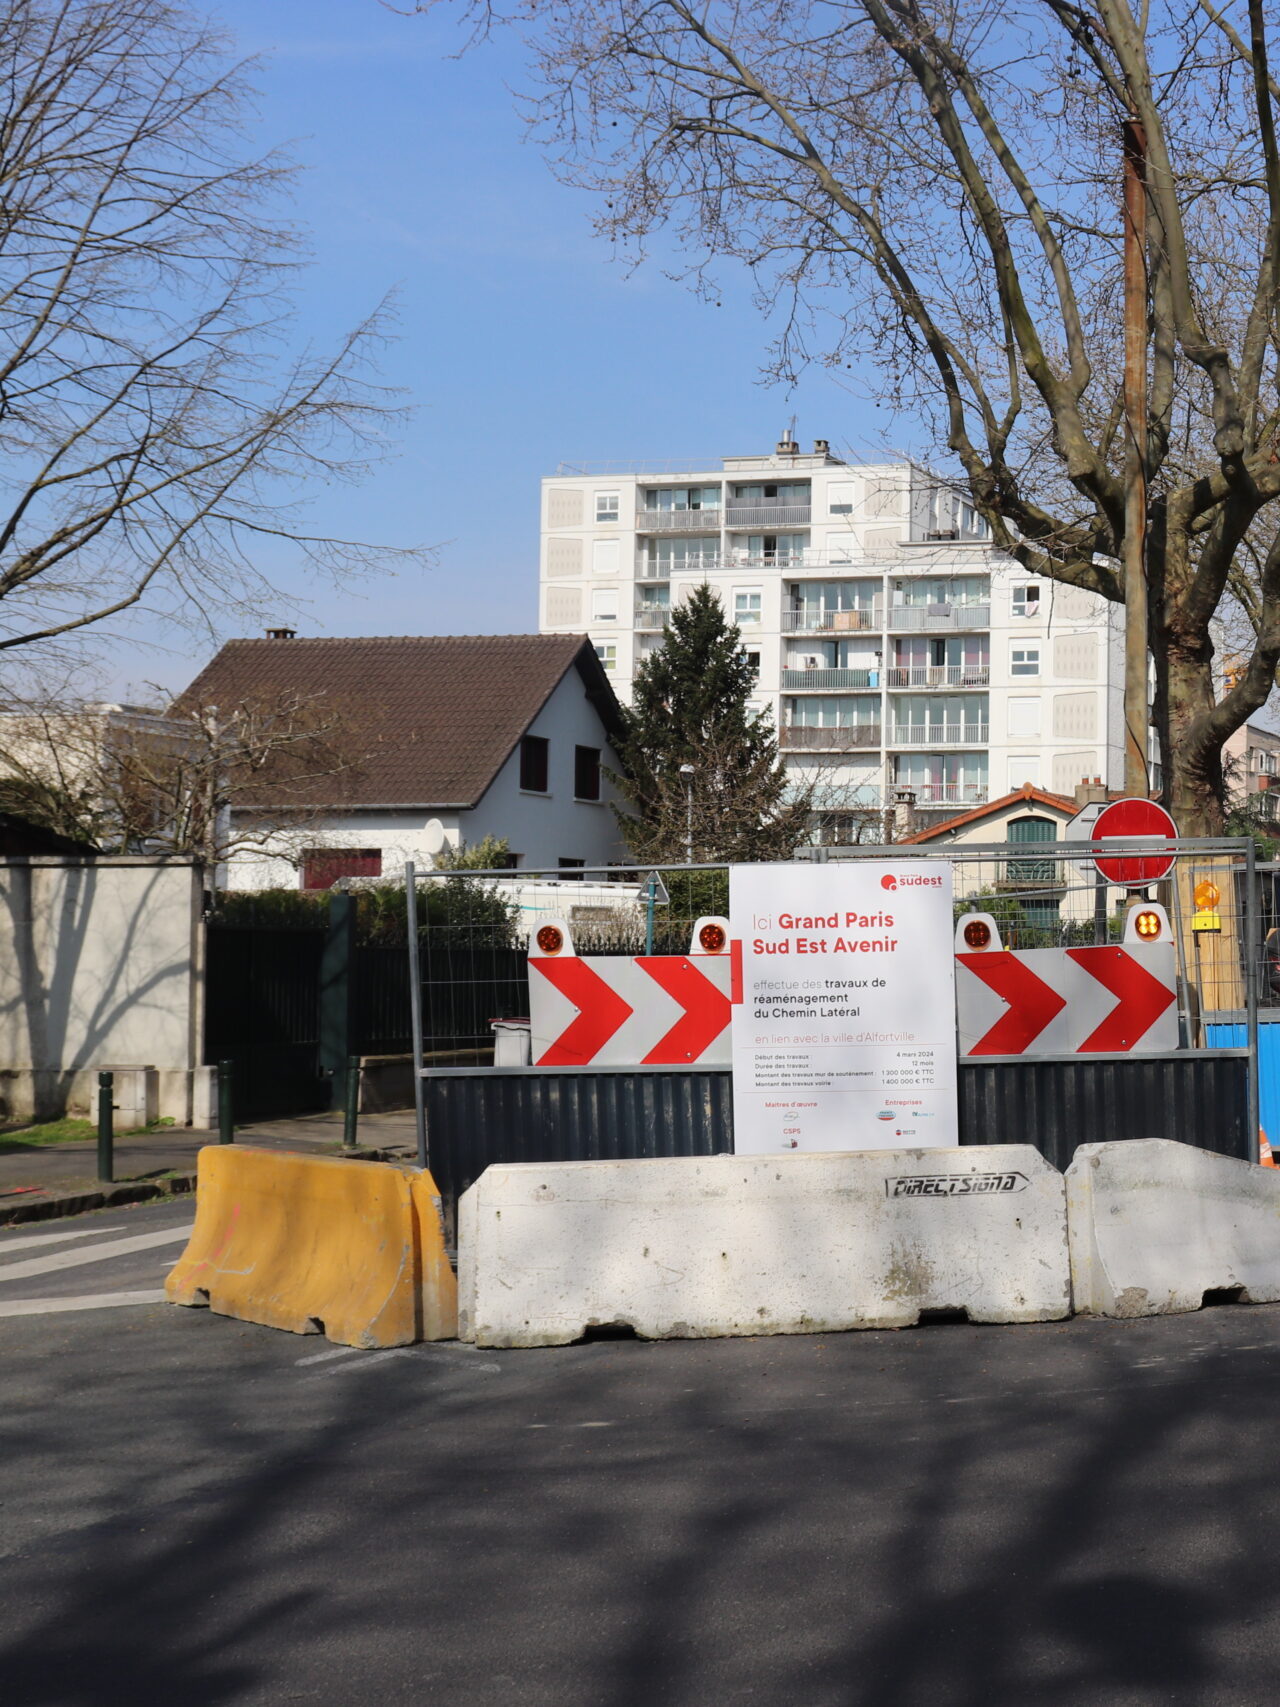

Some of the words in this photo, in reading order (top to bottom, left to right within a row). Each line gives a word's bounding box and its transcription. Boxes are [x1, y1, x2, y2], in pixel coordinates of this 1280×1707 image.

[900, 875, 943, 886] sudest
[753, 914, 772, 930] Ici
[778, 912, 839, 929] Grand
[846, 911, 895, 928] Paris
[753, 938, 789, 954] Sud
[796, 938, 827, 954] Est
[833, 936, 899, 953] Avenir
[754, 979, 799, 990] effectue
[802, 979, 821, 989] des
[825, 978, 868, 989] travaux
[871, 977, 887, 988] de
[754, 993, 849, 1006] réaménagement
[754, 1007, 769, 1018] du
[772, 1006, 817, 1018] Chemin
[820, 1006, 860, 1017] Latéral
[755, 1036, 769, 1044] en
[771, 1033, 790, 1043] lien
[793, 1035, 818, 1043] avec
[821, 1032, 830, 1042] la
[834, 1032, 853, 1042] ville
[856, 1031, 915, 1042] d'Alfortville
[884, 1099, 922, 1107] Entreprises
[783, 1127, 802, 1135] CSPS
